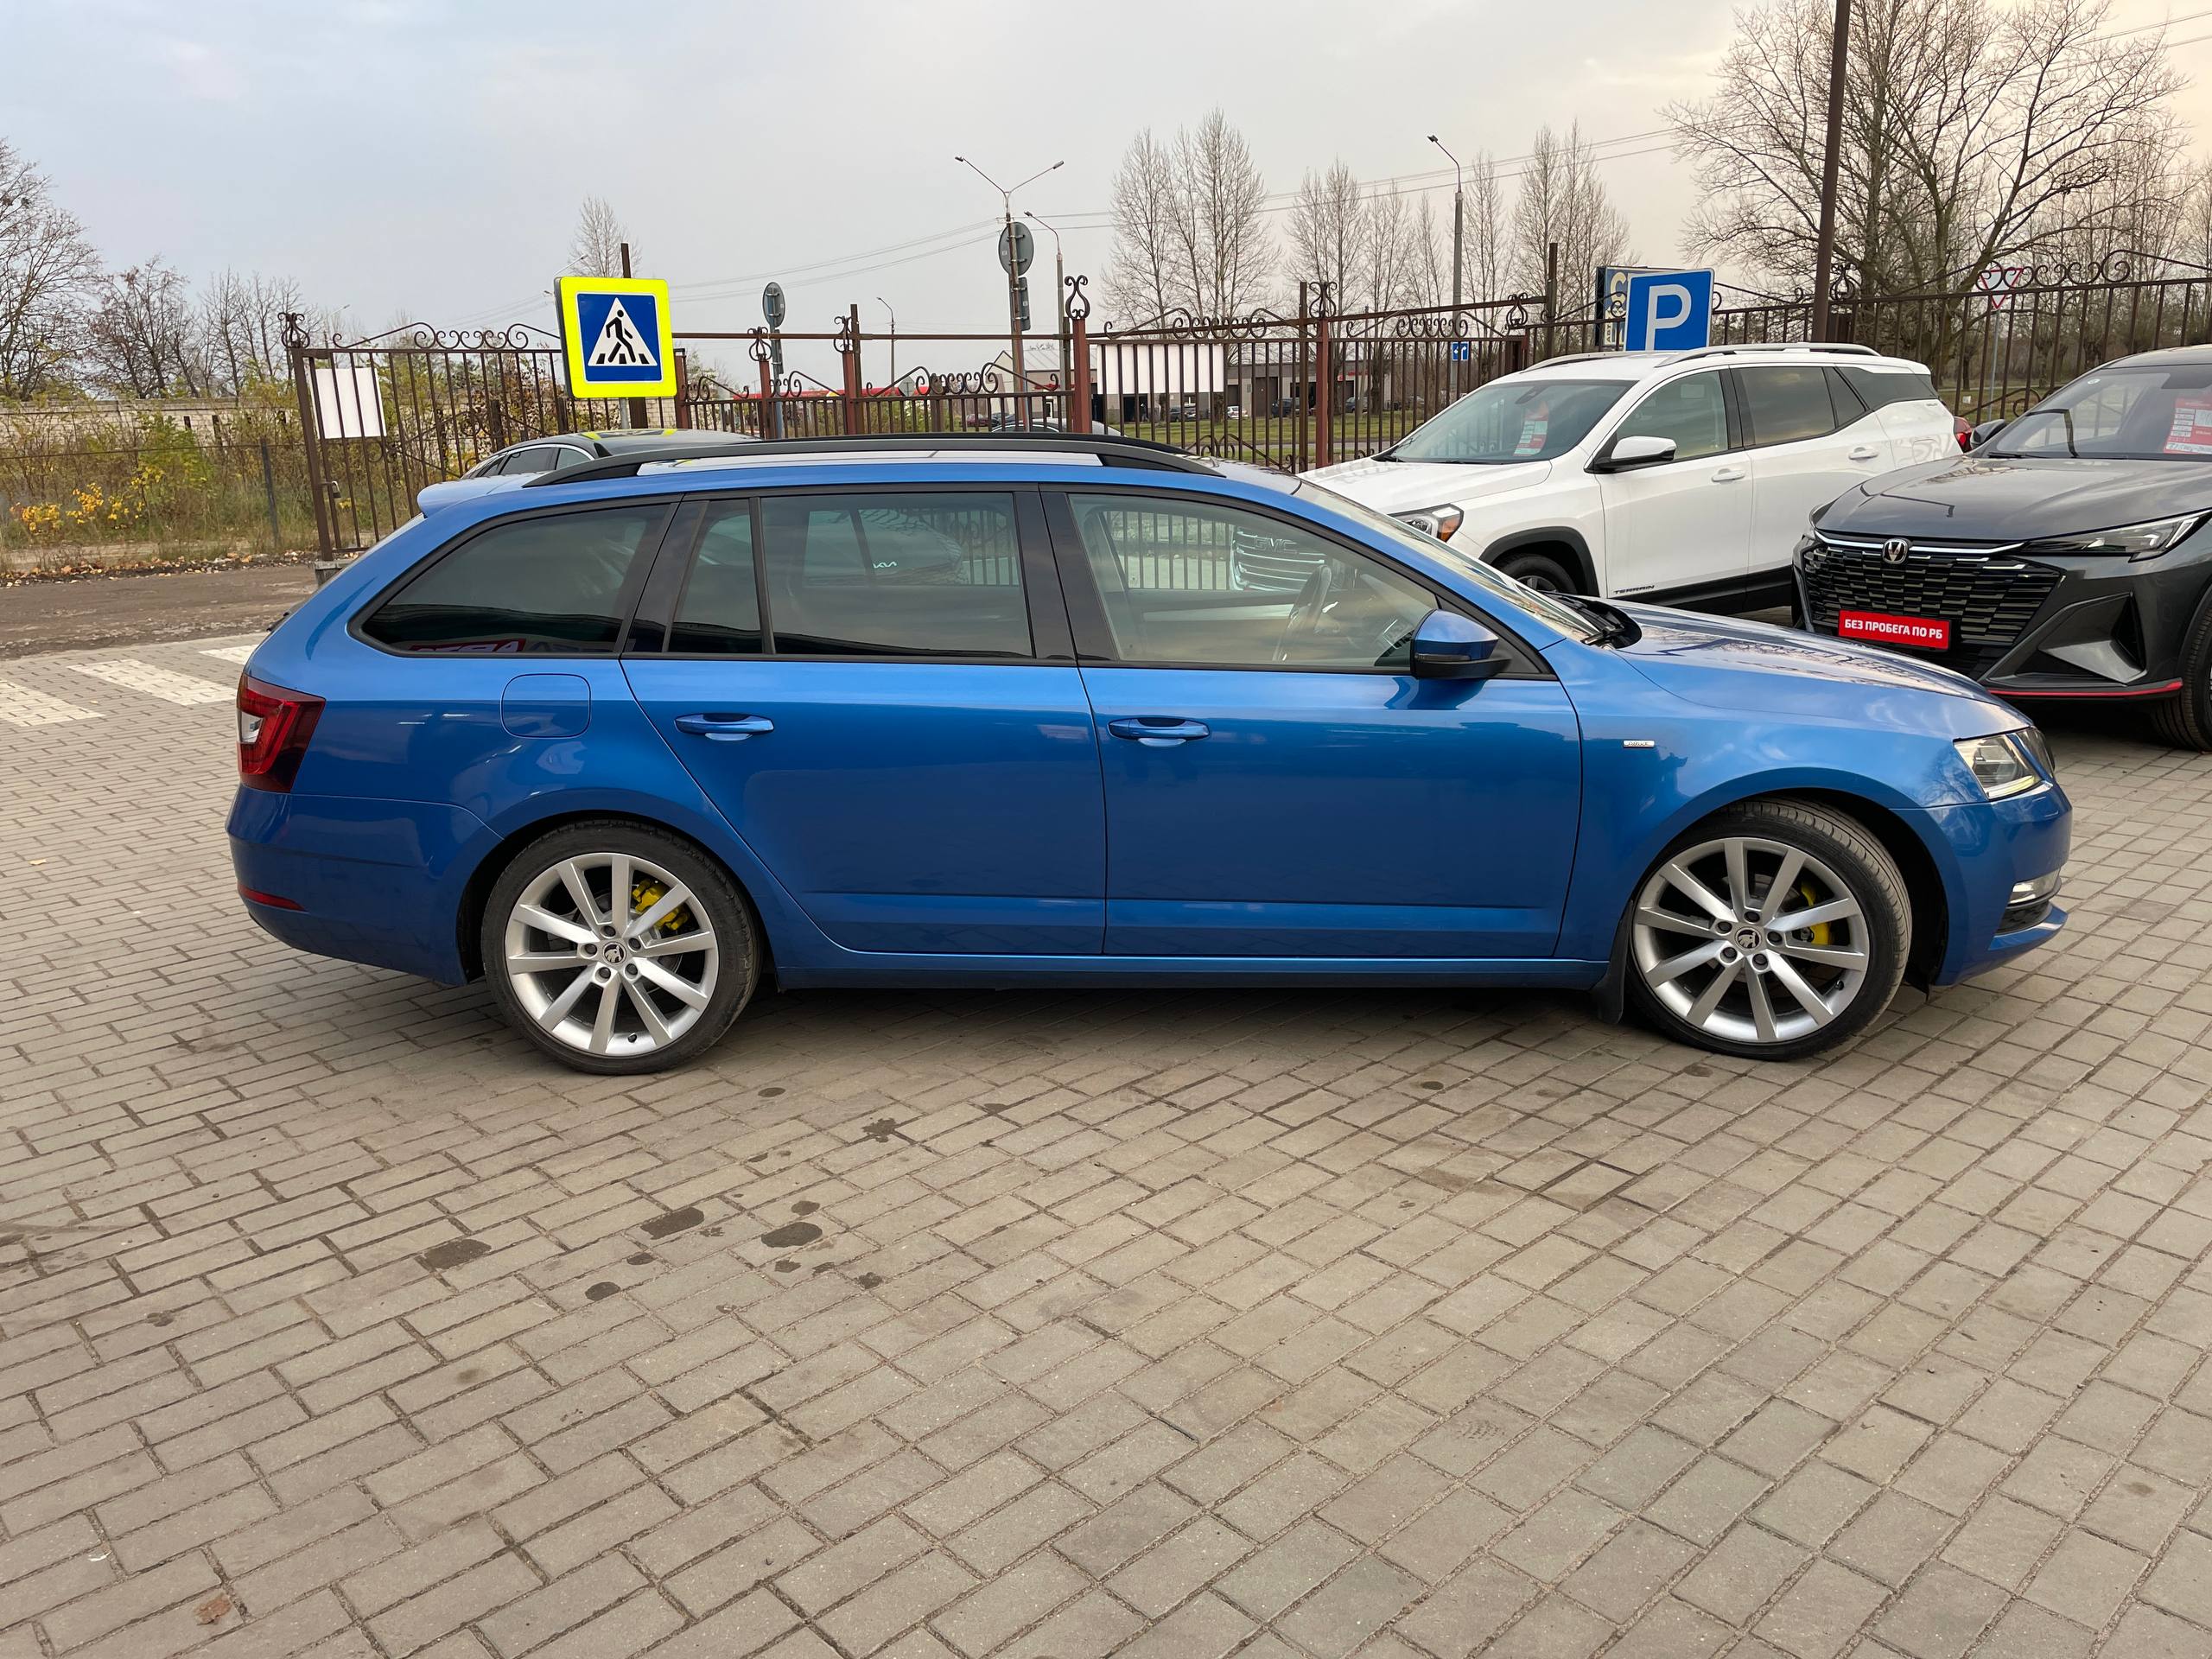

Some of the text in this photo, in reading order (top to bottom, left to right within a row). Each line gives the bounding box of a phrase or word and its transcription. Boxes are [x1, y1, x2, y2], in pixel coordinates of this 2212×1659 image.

[1645, 283, 1692, 350] P
[1845, 619, 1943, 639] БЕЗ ПРОБЕГА ПО РБ
